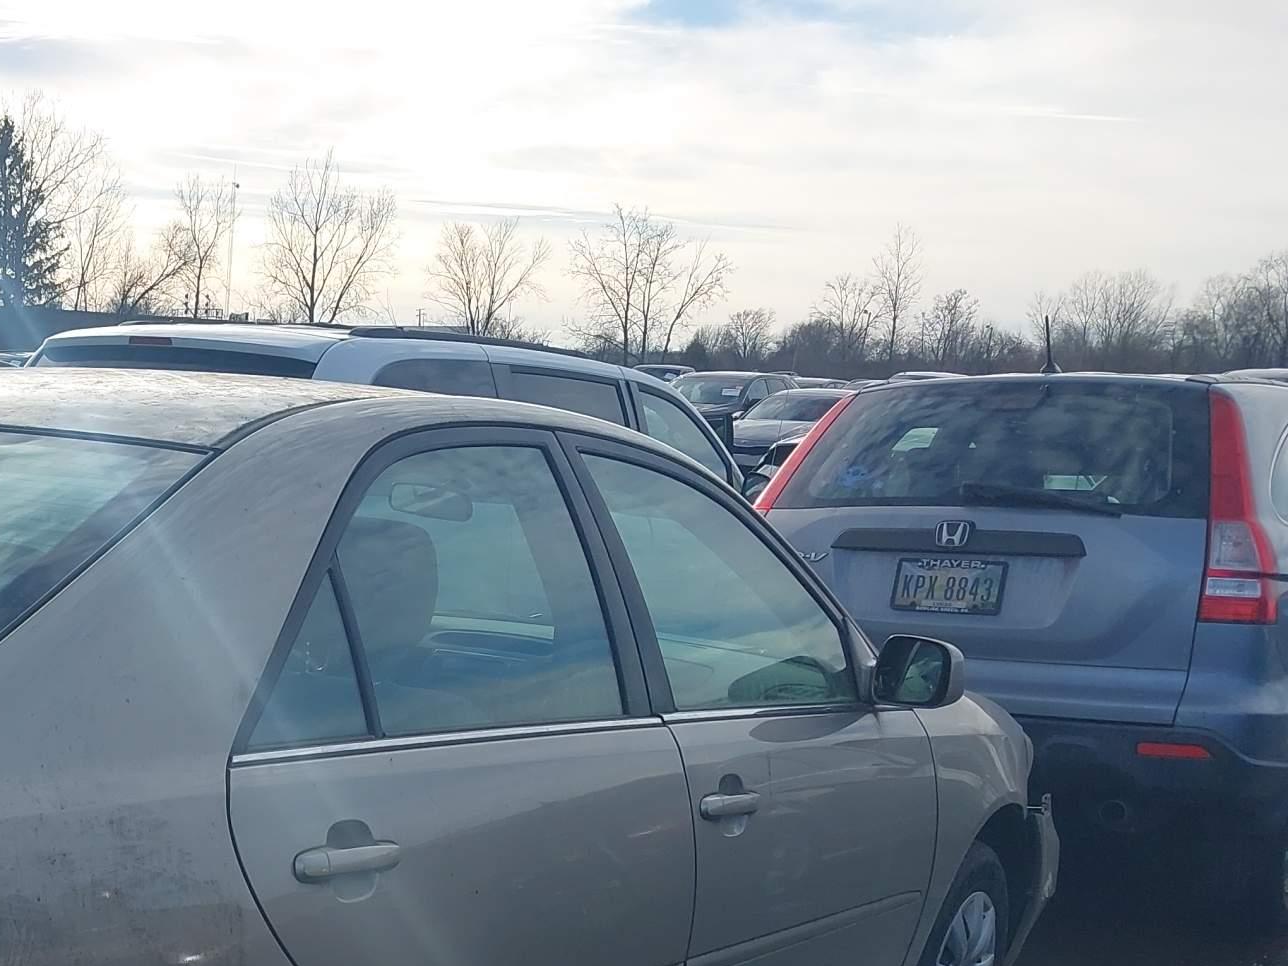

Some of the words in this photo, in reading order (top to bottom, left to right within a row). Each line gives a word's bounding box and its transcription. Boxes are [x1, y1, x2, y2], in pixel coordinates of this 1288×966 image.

[922, 559, 981, 569] THAYER
[901, 574, 938, 600] KPX
[943, 576, 994, 602] 8843
